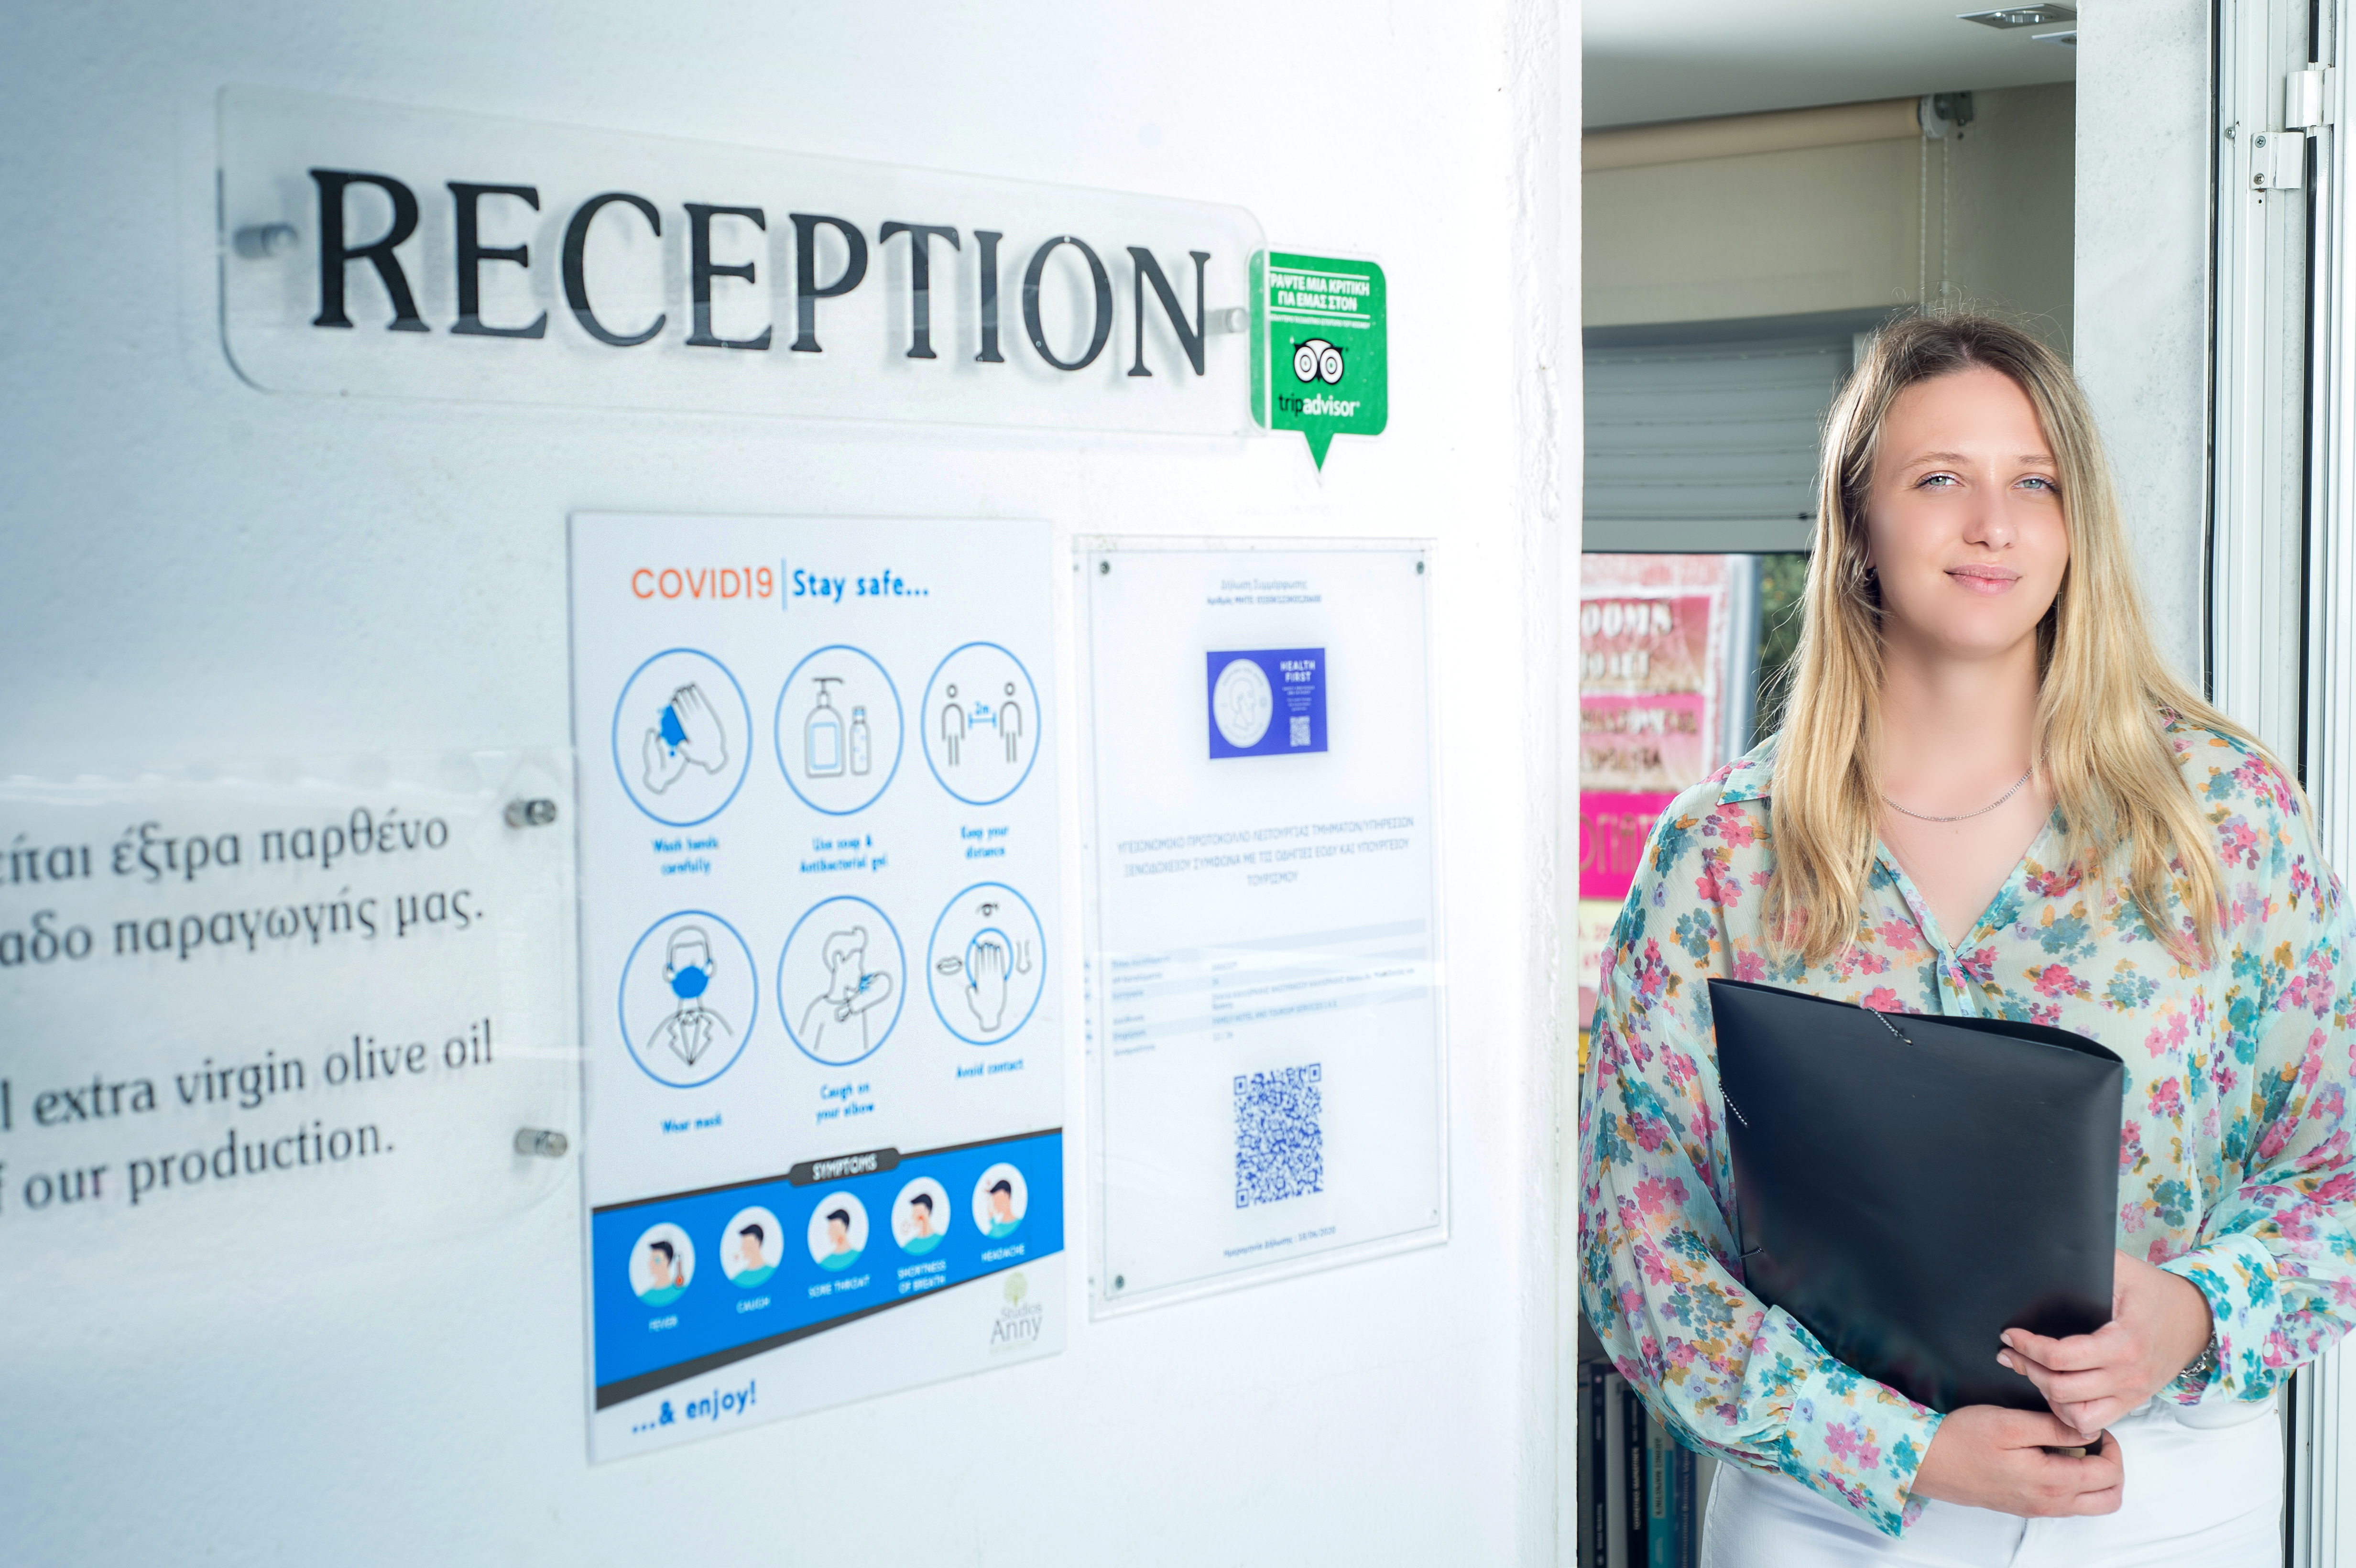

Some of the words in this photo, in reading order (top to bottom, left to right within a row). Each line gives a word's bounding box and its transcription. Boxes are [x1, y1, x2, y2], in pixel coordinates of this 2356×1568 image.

[310, 168, 1211, 377] RECEPTION
[1270, 273, 1306, 291] ΡΑΨΤΕ
[1307, 277, 1328, 292] ΜΙΑ
[1329, 279, 1370, 296] ΚΡΙΤΙΚΗ
[1278, 291, 1296, 306] ΓΙΑ
[1296, 292, 1327, 308] ΕΜΑΣ
[1327, 295, 1357, 311] ΣΤΟΝ
[1279, 393, 1355, 417] tripadvisor
[632, 567, 773, 599] COVID19
[793, 570, 845, 603] Stay
[856, 570, 929, 598] safe...
[1280, 660, 1316, 672] HEALTH
[1285, 671, 1312, 683] FIRST
[0, 831, 93, 884] ίται
[111, 820, 240, 883] έξτρα
[261, 807, 448, 868] παρθένο
[114, 886, 377, 960] παραγωγής
[395, 887, 485, 938] μας.
[33, 1073, 157, 1128] extra
[175, 1050, 305, 1110] virgin
[325, 1034, 426, 1088] olive
[445, 1017, 493, 1070] oil
[24, 1165, 108, 1211] our
[127, 1121, 395, 1206] production.
[813, 1154, 877, 1181] SYMPTOMS
[648, 1314, 678, 1333] FEVER
[991, 1316, 1042, 1344] Anny
[687, 1380, 755, 1420] enjoy!
